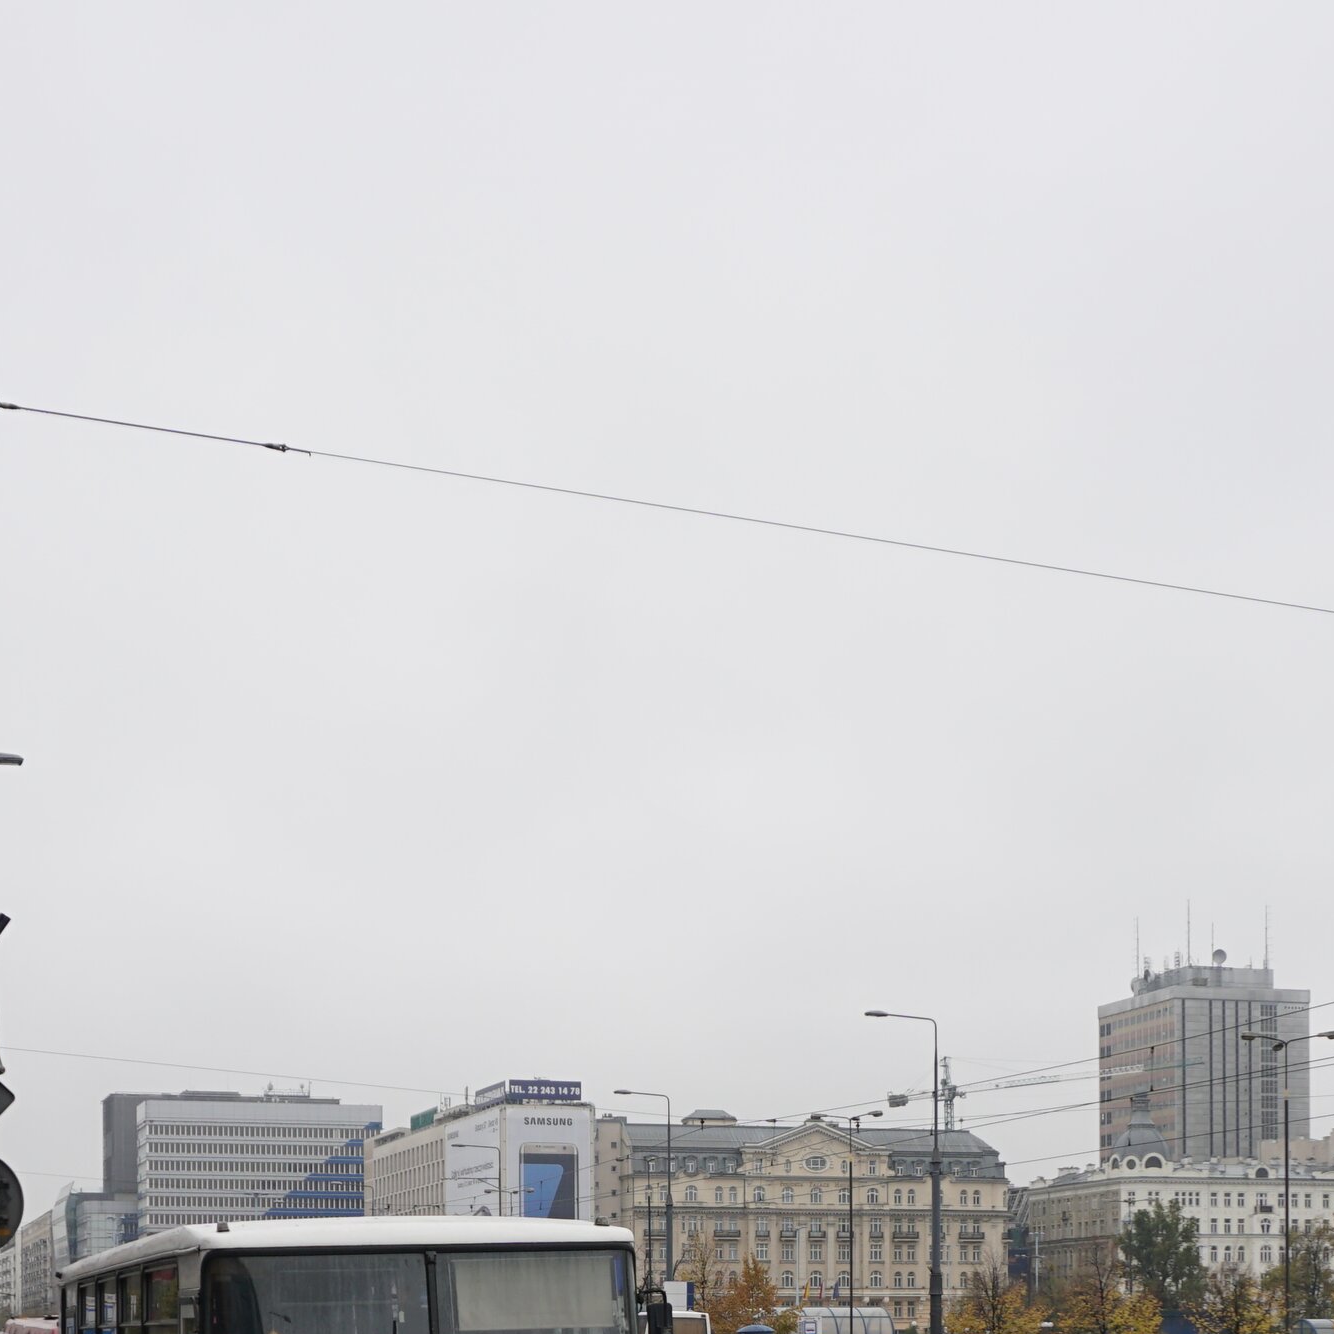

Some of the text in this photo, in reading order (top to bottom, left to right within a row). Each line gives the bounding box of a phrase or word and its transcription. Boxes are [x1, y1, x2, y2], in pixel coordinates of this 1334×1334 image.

[510, 1085, 581, 1095] TEL. 22 243 14 78
[523, 1117, 573, 1127] SAMSUNG
